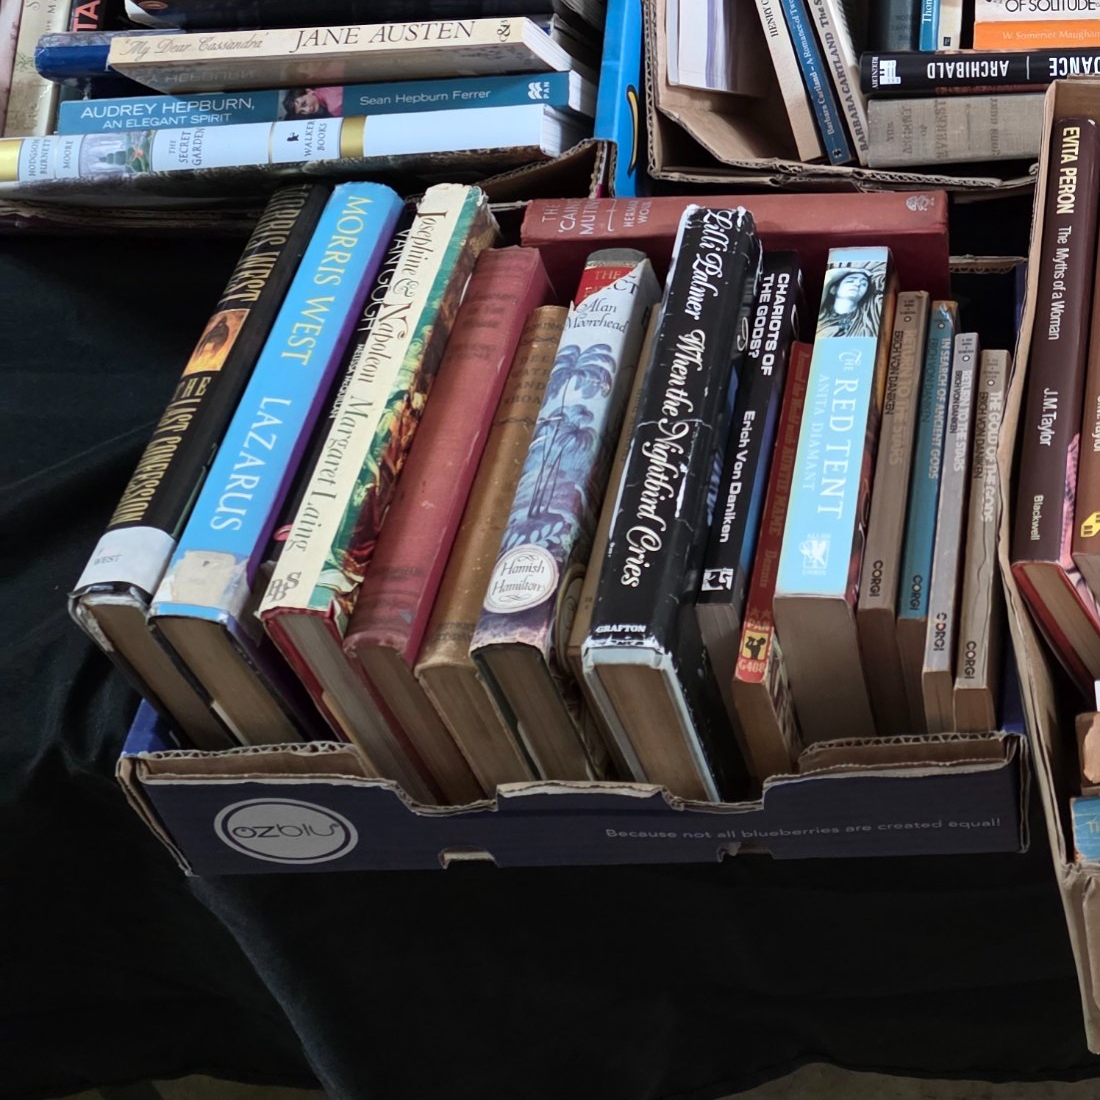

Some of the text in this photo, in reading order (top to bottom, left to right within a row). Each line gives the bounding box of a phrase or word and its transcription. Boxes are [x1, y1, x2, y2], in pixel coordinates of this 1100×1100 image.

[1005, 0, 1026, 12] OF
[290, 21, 475, 53] JANE AUSTEN
[927, 59, 1009, 78] ARCHIBALD
[80, 98, 255, 119] AUDREY HEPBURN,
[360, 90, 491, 106] Sean Hepburn Ferrer
[102, 113, 232, 130] AN ELEGANT SPIRIT
[1056, 125, 1080, 215] EVITA PERON
[281, 195, 374, 366] MORRIS WEST
[210, 396, 291, 531] LAZARUS
[816, 376, 859, 520] RED TENT
[719, 410, 756, 543] Erich Von Daniken
[492, 562, 545, 595] Hamish Hamilton
[606, 817, 1001, 840] Because not all blueberries are created equal!
